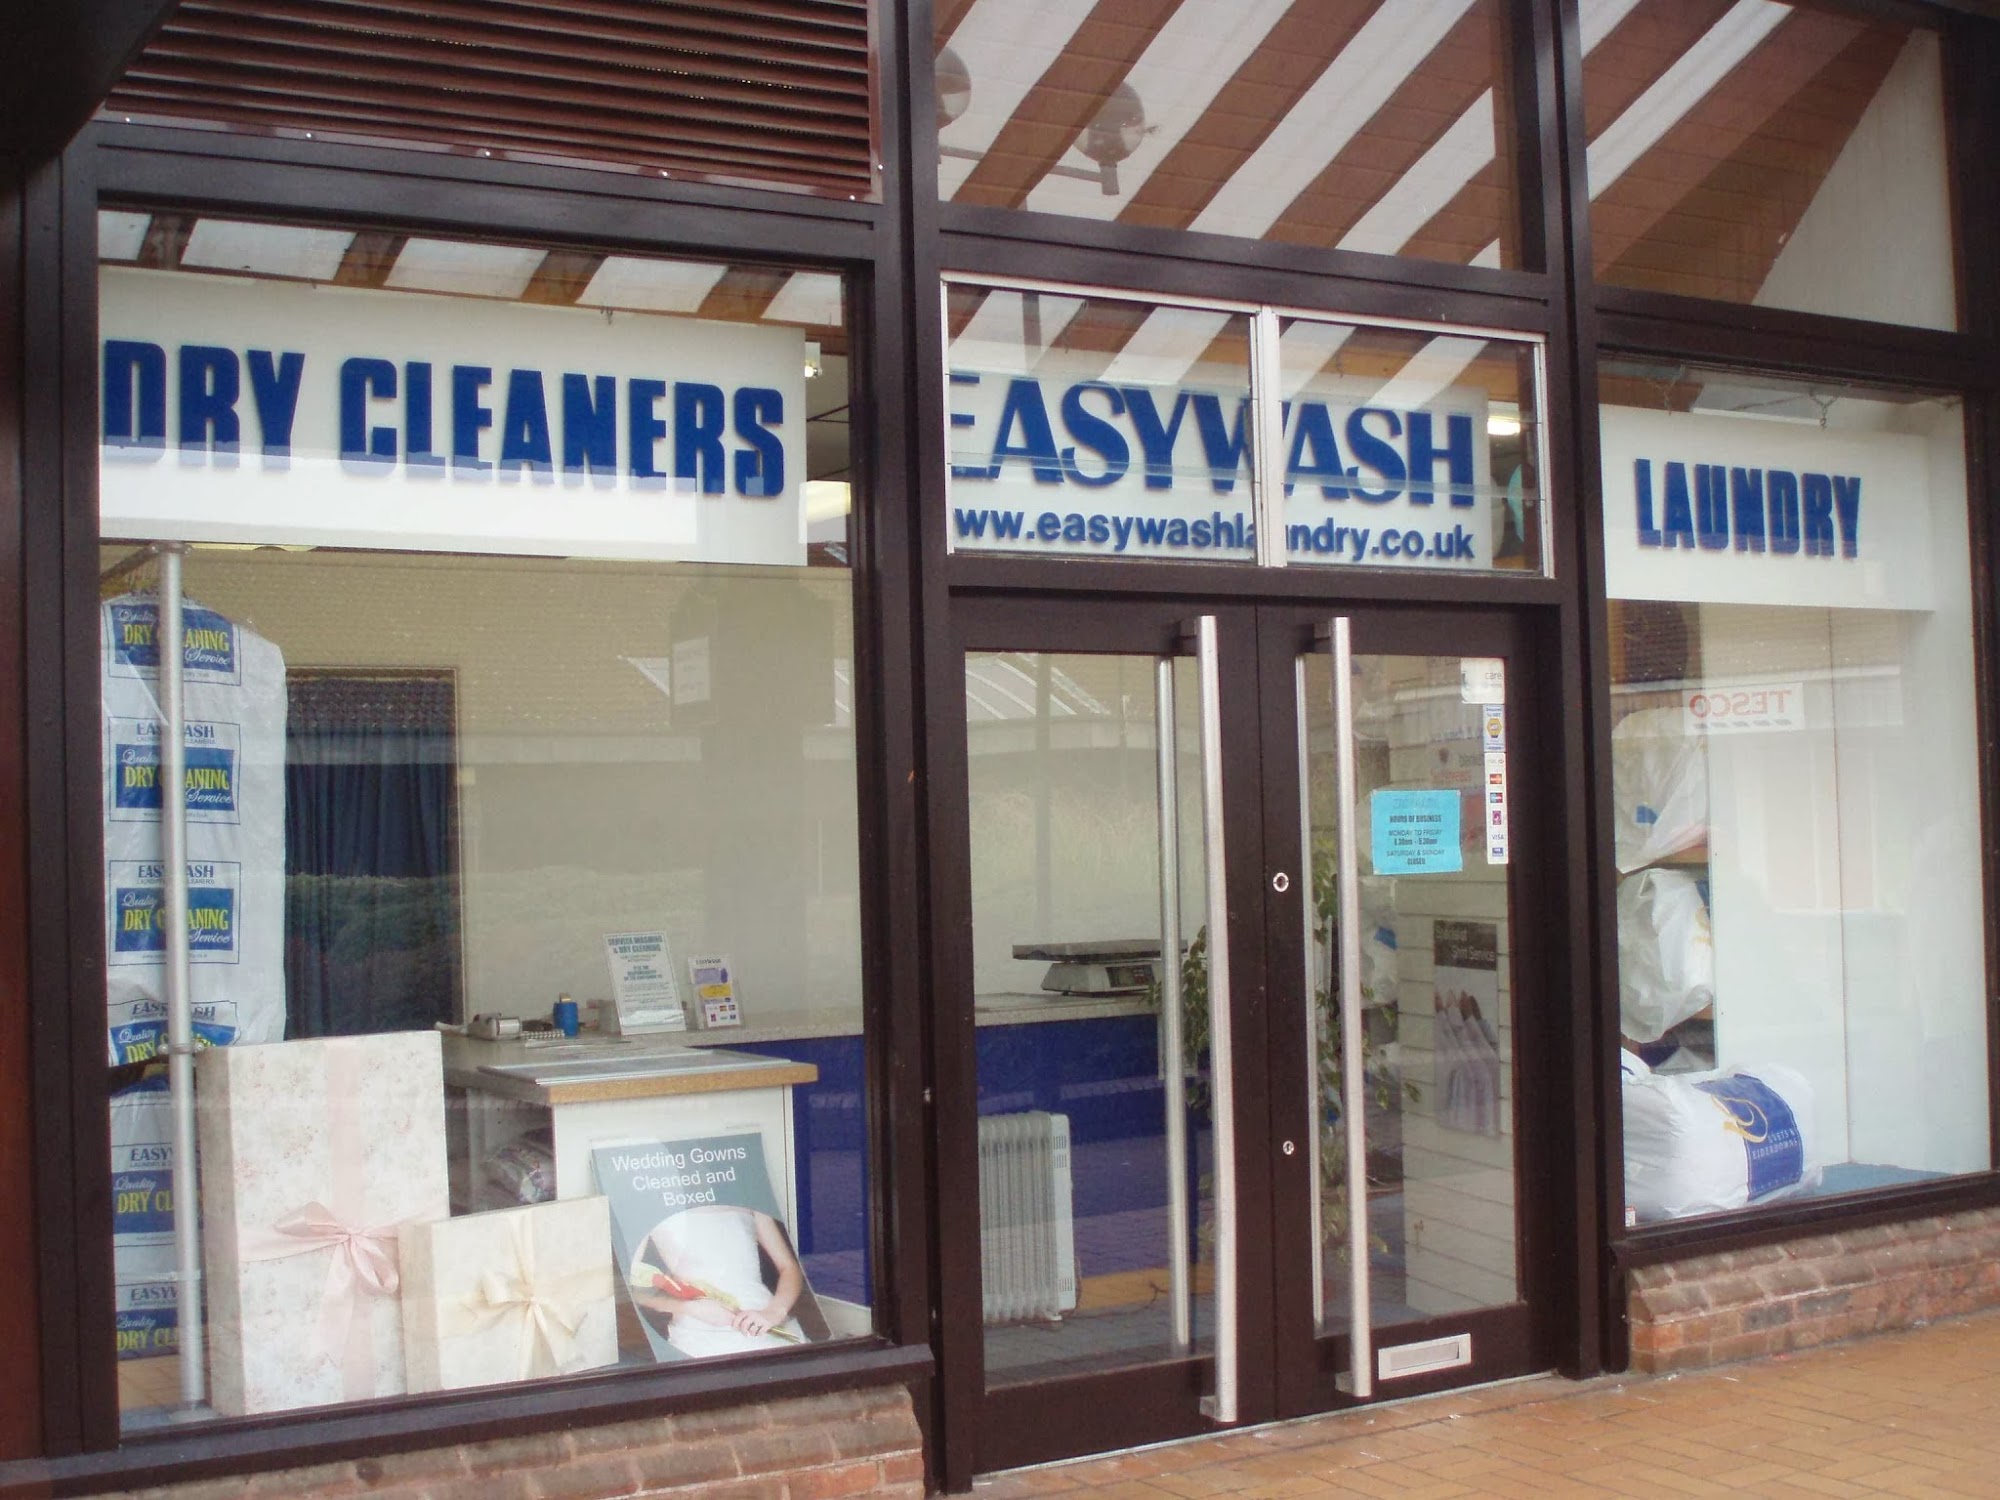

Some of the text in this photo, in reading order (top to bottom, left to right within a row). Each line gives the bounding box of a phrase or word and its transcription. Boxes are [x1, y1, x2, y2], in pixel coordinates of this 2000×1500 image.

[104, 339, 785, 499] DRY CLEANERS
[1634, 458, 1861, 559] LAUNDRY
[124, 624, 153, 646] DRY
[184, 647, 231, 666] Service
[125, 765, 155, 788] DRY
[185, 788, 232, 804] Service
[1386, 849, 1415, 857] SATURDAY
[1407, 857, 1426, 866] CLOSED
[124, 909, 152, 931] DRY
[188, 927, 231, 943] Service
[119, 1028, 156, 1044] Quality
[126, 1041, 157, 1063] DRY
[611, 1146, 747, 1172] Wedding Gowns
[632, 1166, 736, 1192] Cleaned and
[117, 1191, 151, 1214] DRY
[663, 1188, 716, 1207] Boxed
[116, 1330, 148, 1352] DRY
